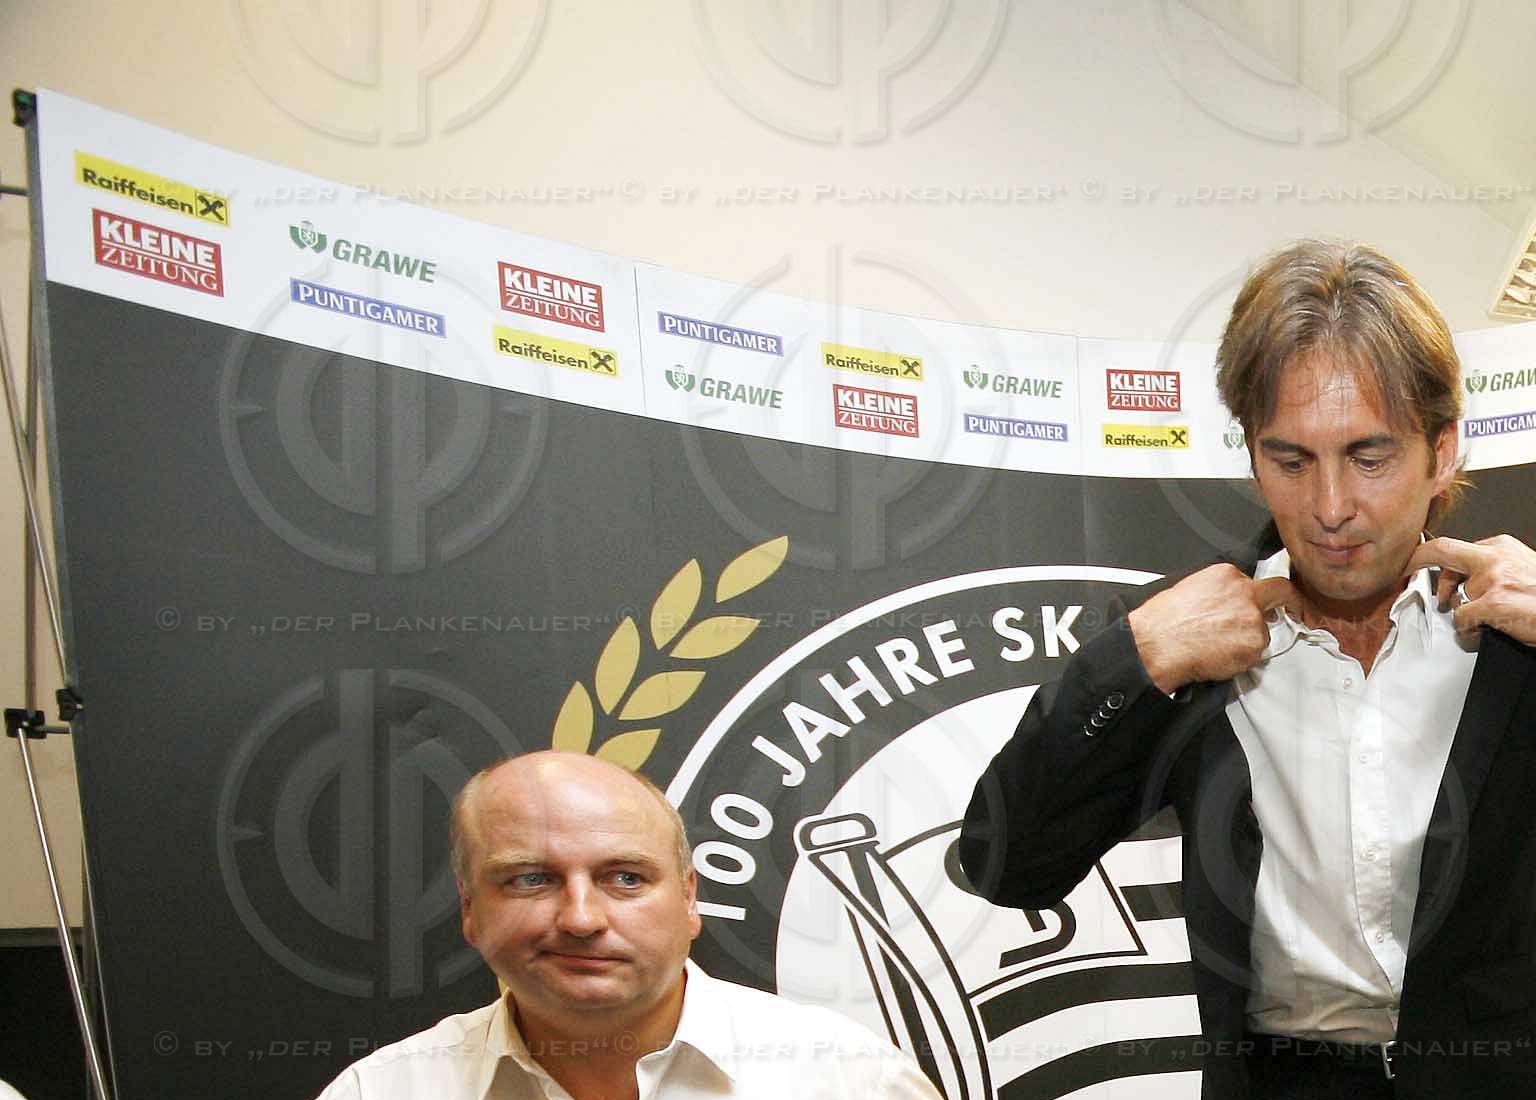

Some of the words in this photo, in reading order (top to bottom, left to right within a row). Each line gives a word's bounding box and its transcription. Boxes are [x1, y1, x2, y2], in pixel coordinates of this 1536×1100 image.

[82, 167, 194, 216] Raiffeisen
[99, 215, 216, 269] KLEINE
[101, 244, 218, 292] ZEITUNG
[332, 239, 438, 283] GRAWE
[503, 268, 600, 308] KLEINE
[298, 286, 441, 335] PUNTIGAMER
[504, 294, 603, 330] ZEITUNG
[663, 315, 778, 354] PUNTIGAMER
[497, 338, 588, 371] Raiffeisen
[825, 352, 899, 377] Raiffeisen
[700, 377, 784, 411] GRAWE
[991, 375, 1063, 400] GRAWE
[1108, 371, 1179, 395] KLEINE
[837, 390, 915, 419] KLEINE
[1109, 393, 1181, 412] ZEITUNG
[837, 411, 918, 437] ZEITUNG
[967, 416, 1065, 441] PUNTIGAMER
[1104, 432, 1169, 448] Raiffeisen
[692, 793, 774, 921] 100
[752, 620, 975, 788] JAHRE
[991, 604, 1084, 663] SK
